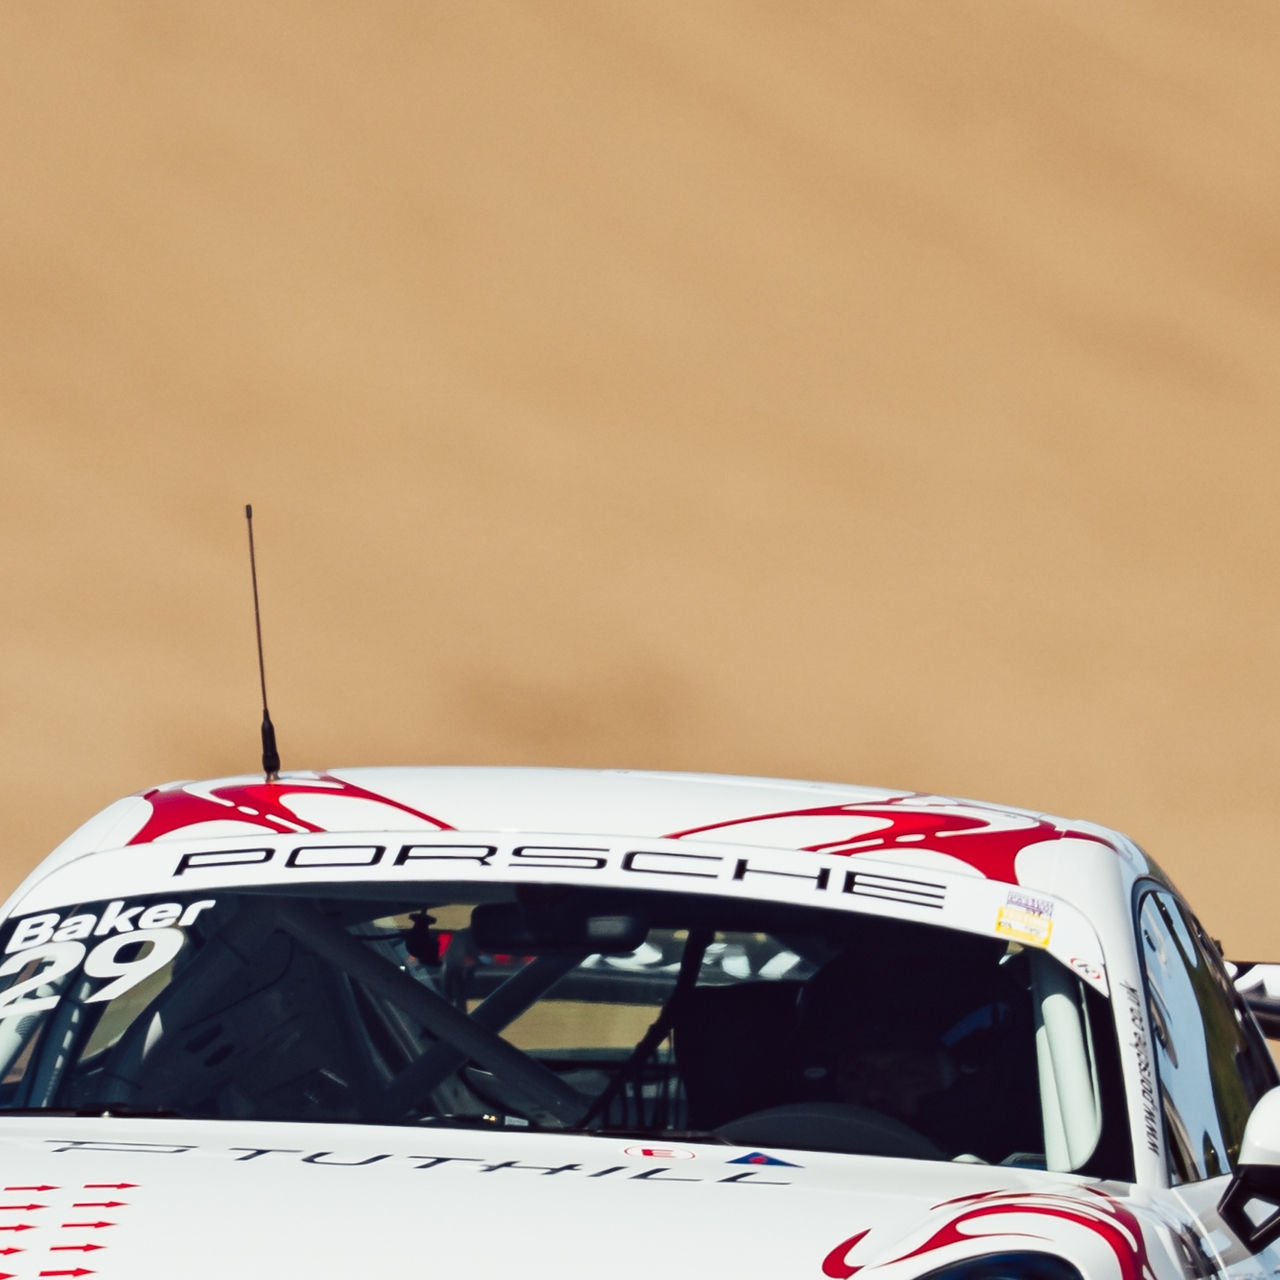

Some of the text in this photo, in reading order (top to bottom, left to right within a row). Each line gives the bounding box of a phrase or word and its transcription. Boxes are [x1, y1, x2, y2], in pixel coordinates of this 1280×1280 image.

[172, 844, 947, 909] PORSCHE
[5, 900, 216, 955] Baker
[1120, 980, 1160, 1155] www.porsche.co.uk
[229, 1147, 792, 1185] TUTHILL
